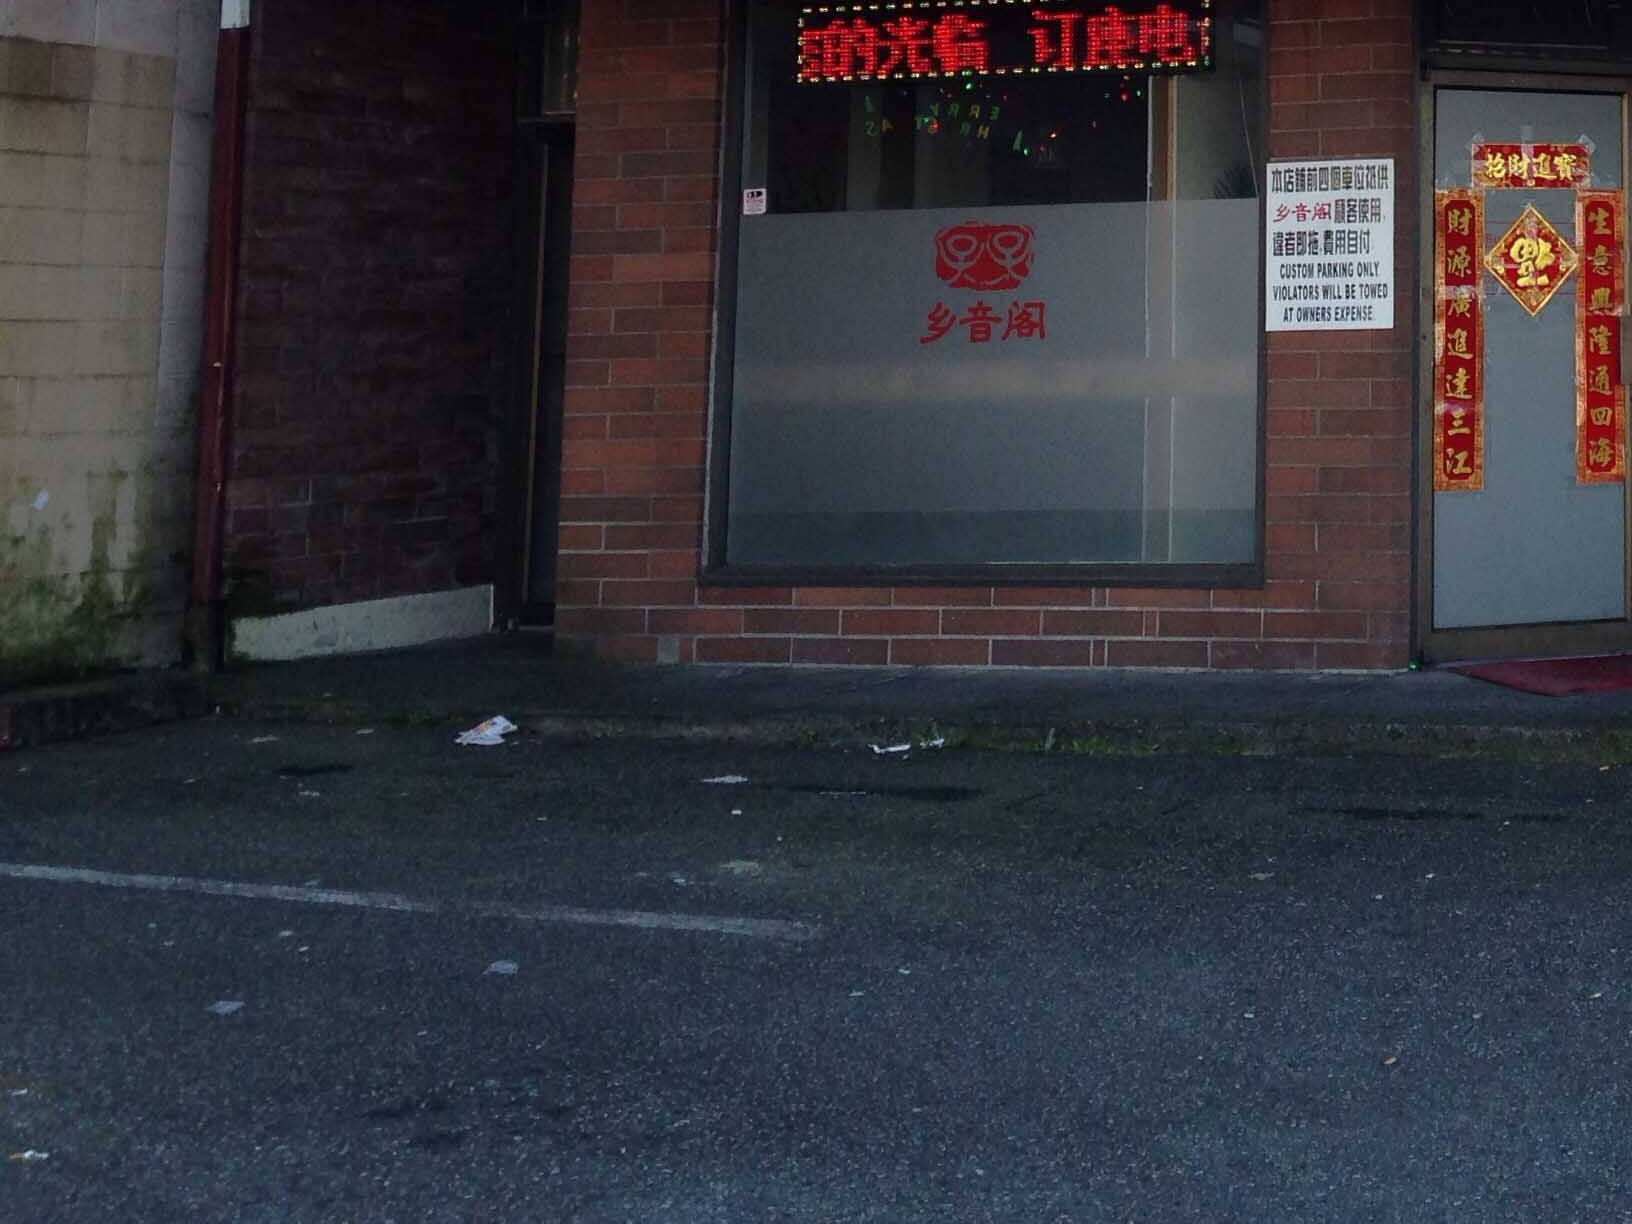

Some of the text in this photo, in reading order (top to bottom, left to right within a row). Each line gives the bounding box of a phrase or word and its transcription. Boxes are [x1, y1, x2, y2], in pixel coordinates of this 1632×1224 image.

[1280, 262, 1379, 279] CUSTOM PARKING ONLY
[1273, 283, 1388, 300] VIOLATORS WILL BE TOWED
[920, 299, 1046, 344] 乡音阁
[1283, 308, 1294, 323] AT
[1297, 307, 1331, 322] OWNERS
